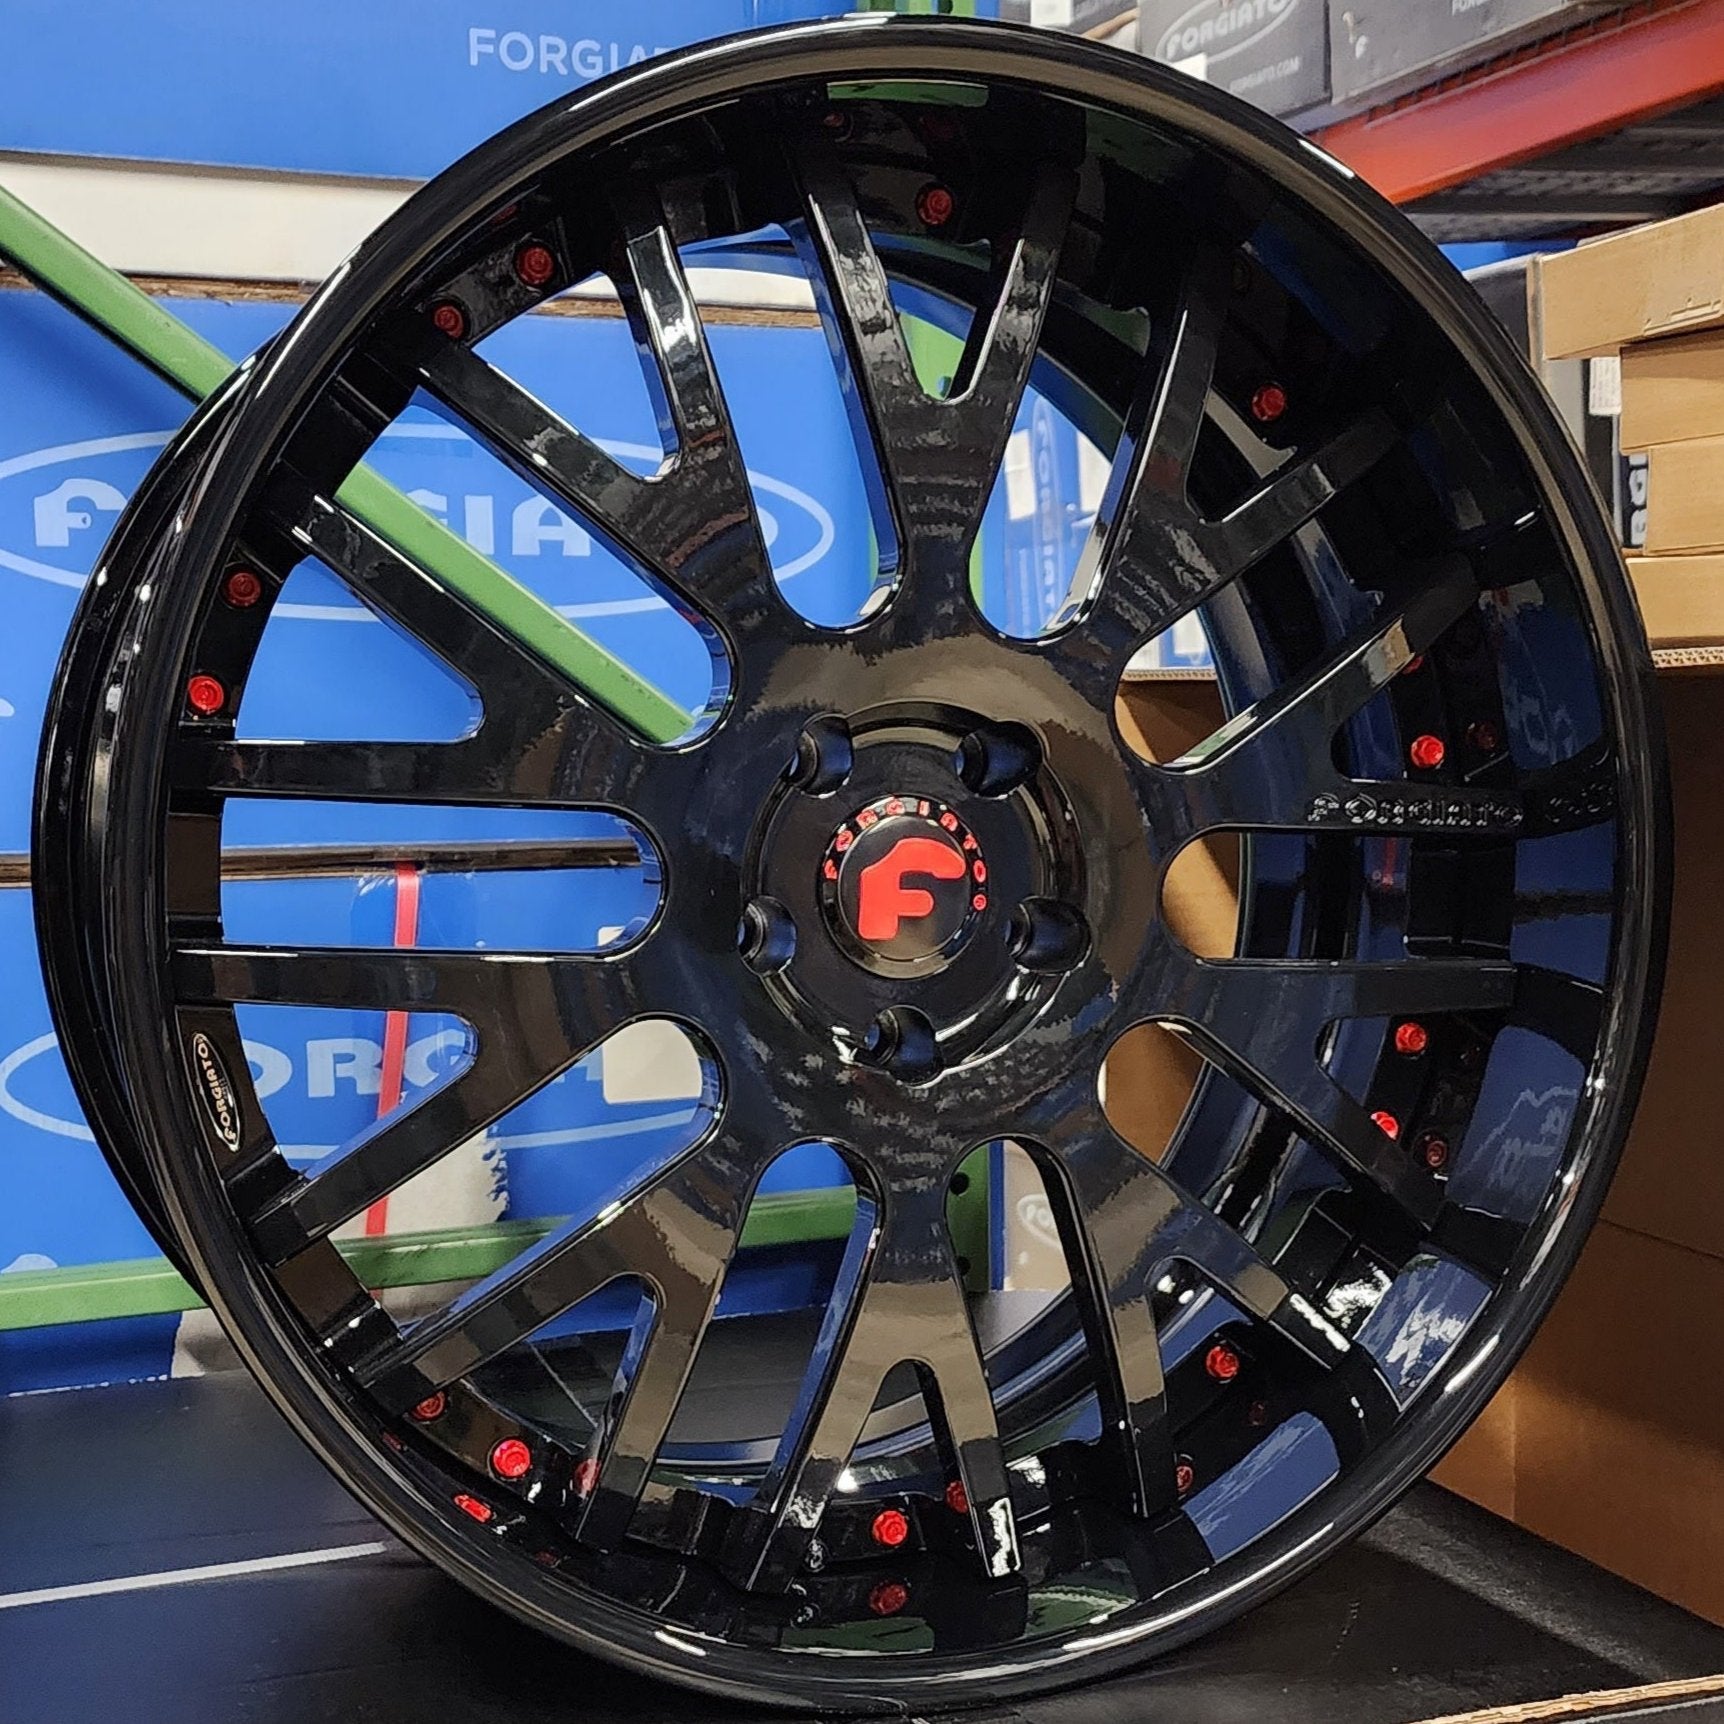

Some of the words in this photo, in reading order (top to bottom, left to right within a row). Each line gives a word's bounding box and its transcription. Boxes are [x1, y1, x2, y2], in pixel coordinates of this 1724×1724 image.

[468, 27, 675, 79] FORGIA
[857, 836, 967, 941] F
[197, 1042, 237, 1142] FORGIATO
